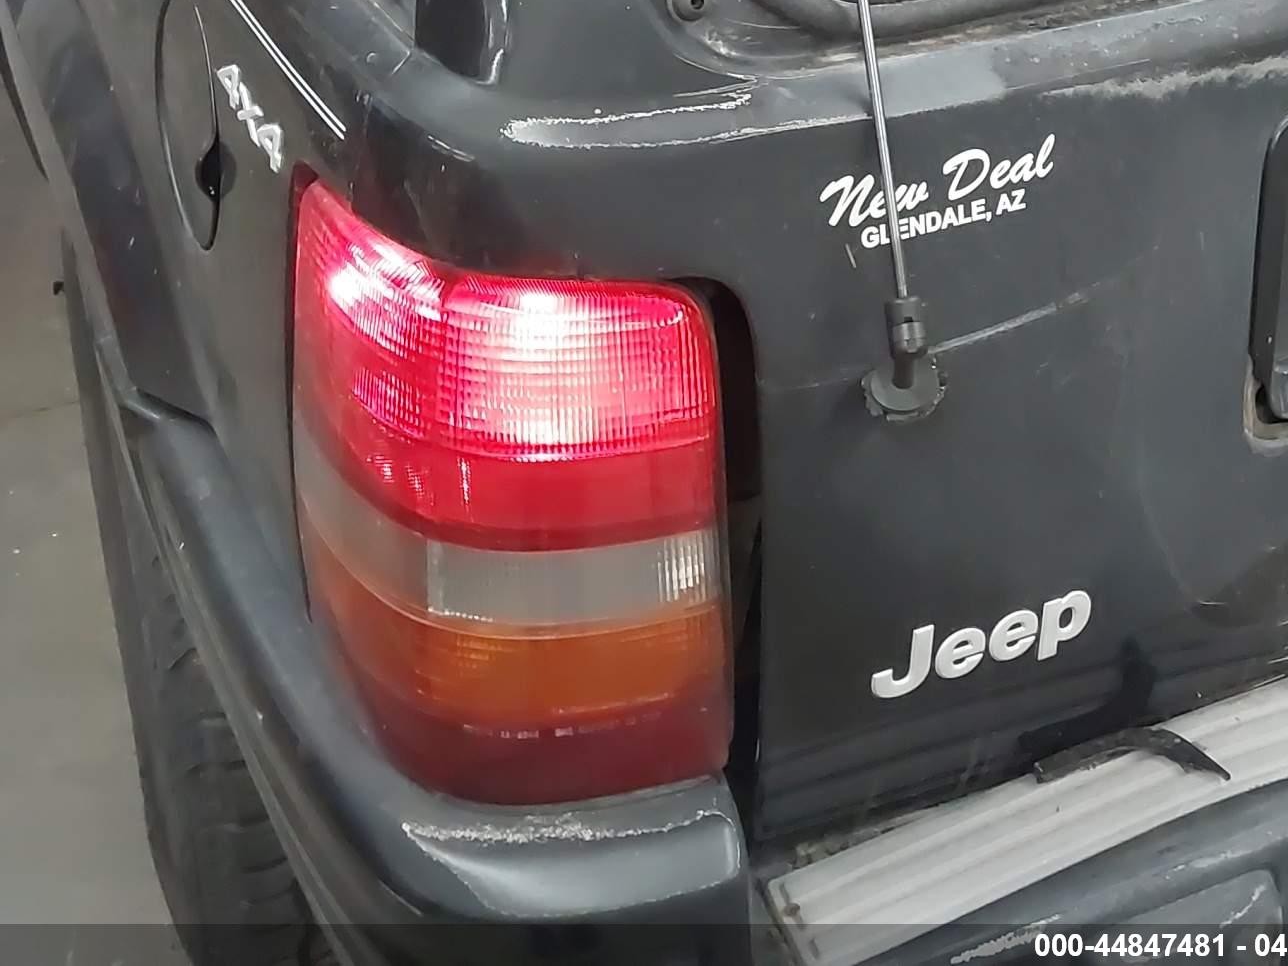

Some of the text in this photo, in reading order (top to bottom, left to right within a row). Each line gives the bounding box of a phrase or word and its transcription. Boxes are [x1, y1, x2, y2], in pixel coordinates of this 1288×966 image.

[819, 133, 1056, 227] New Deal
[861, 188, 1026, 248] GLENDALE, AZ
[871, 590, 1092, 699] Jeep
